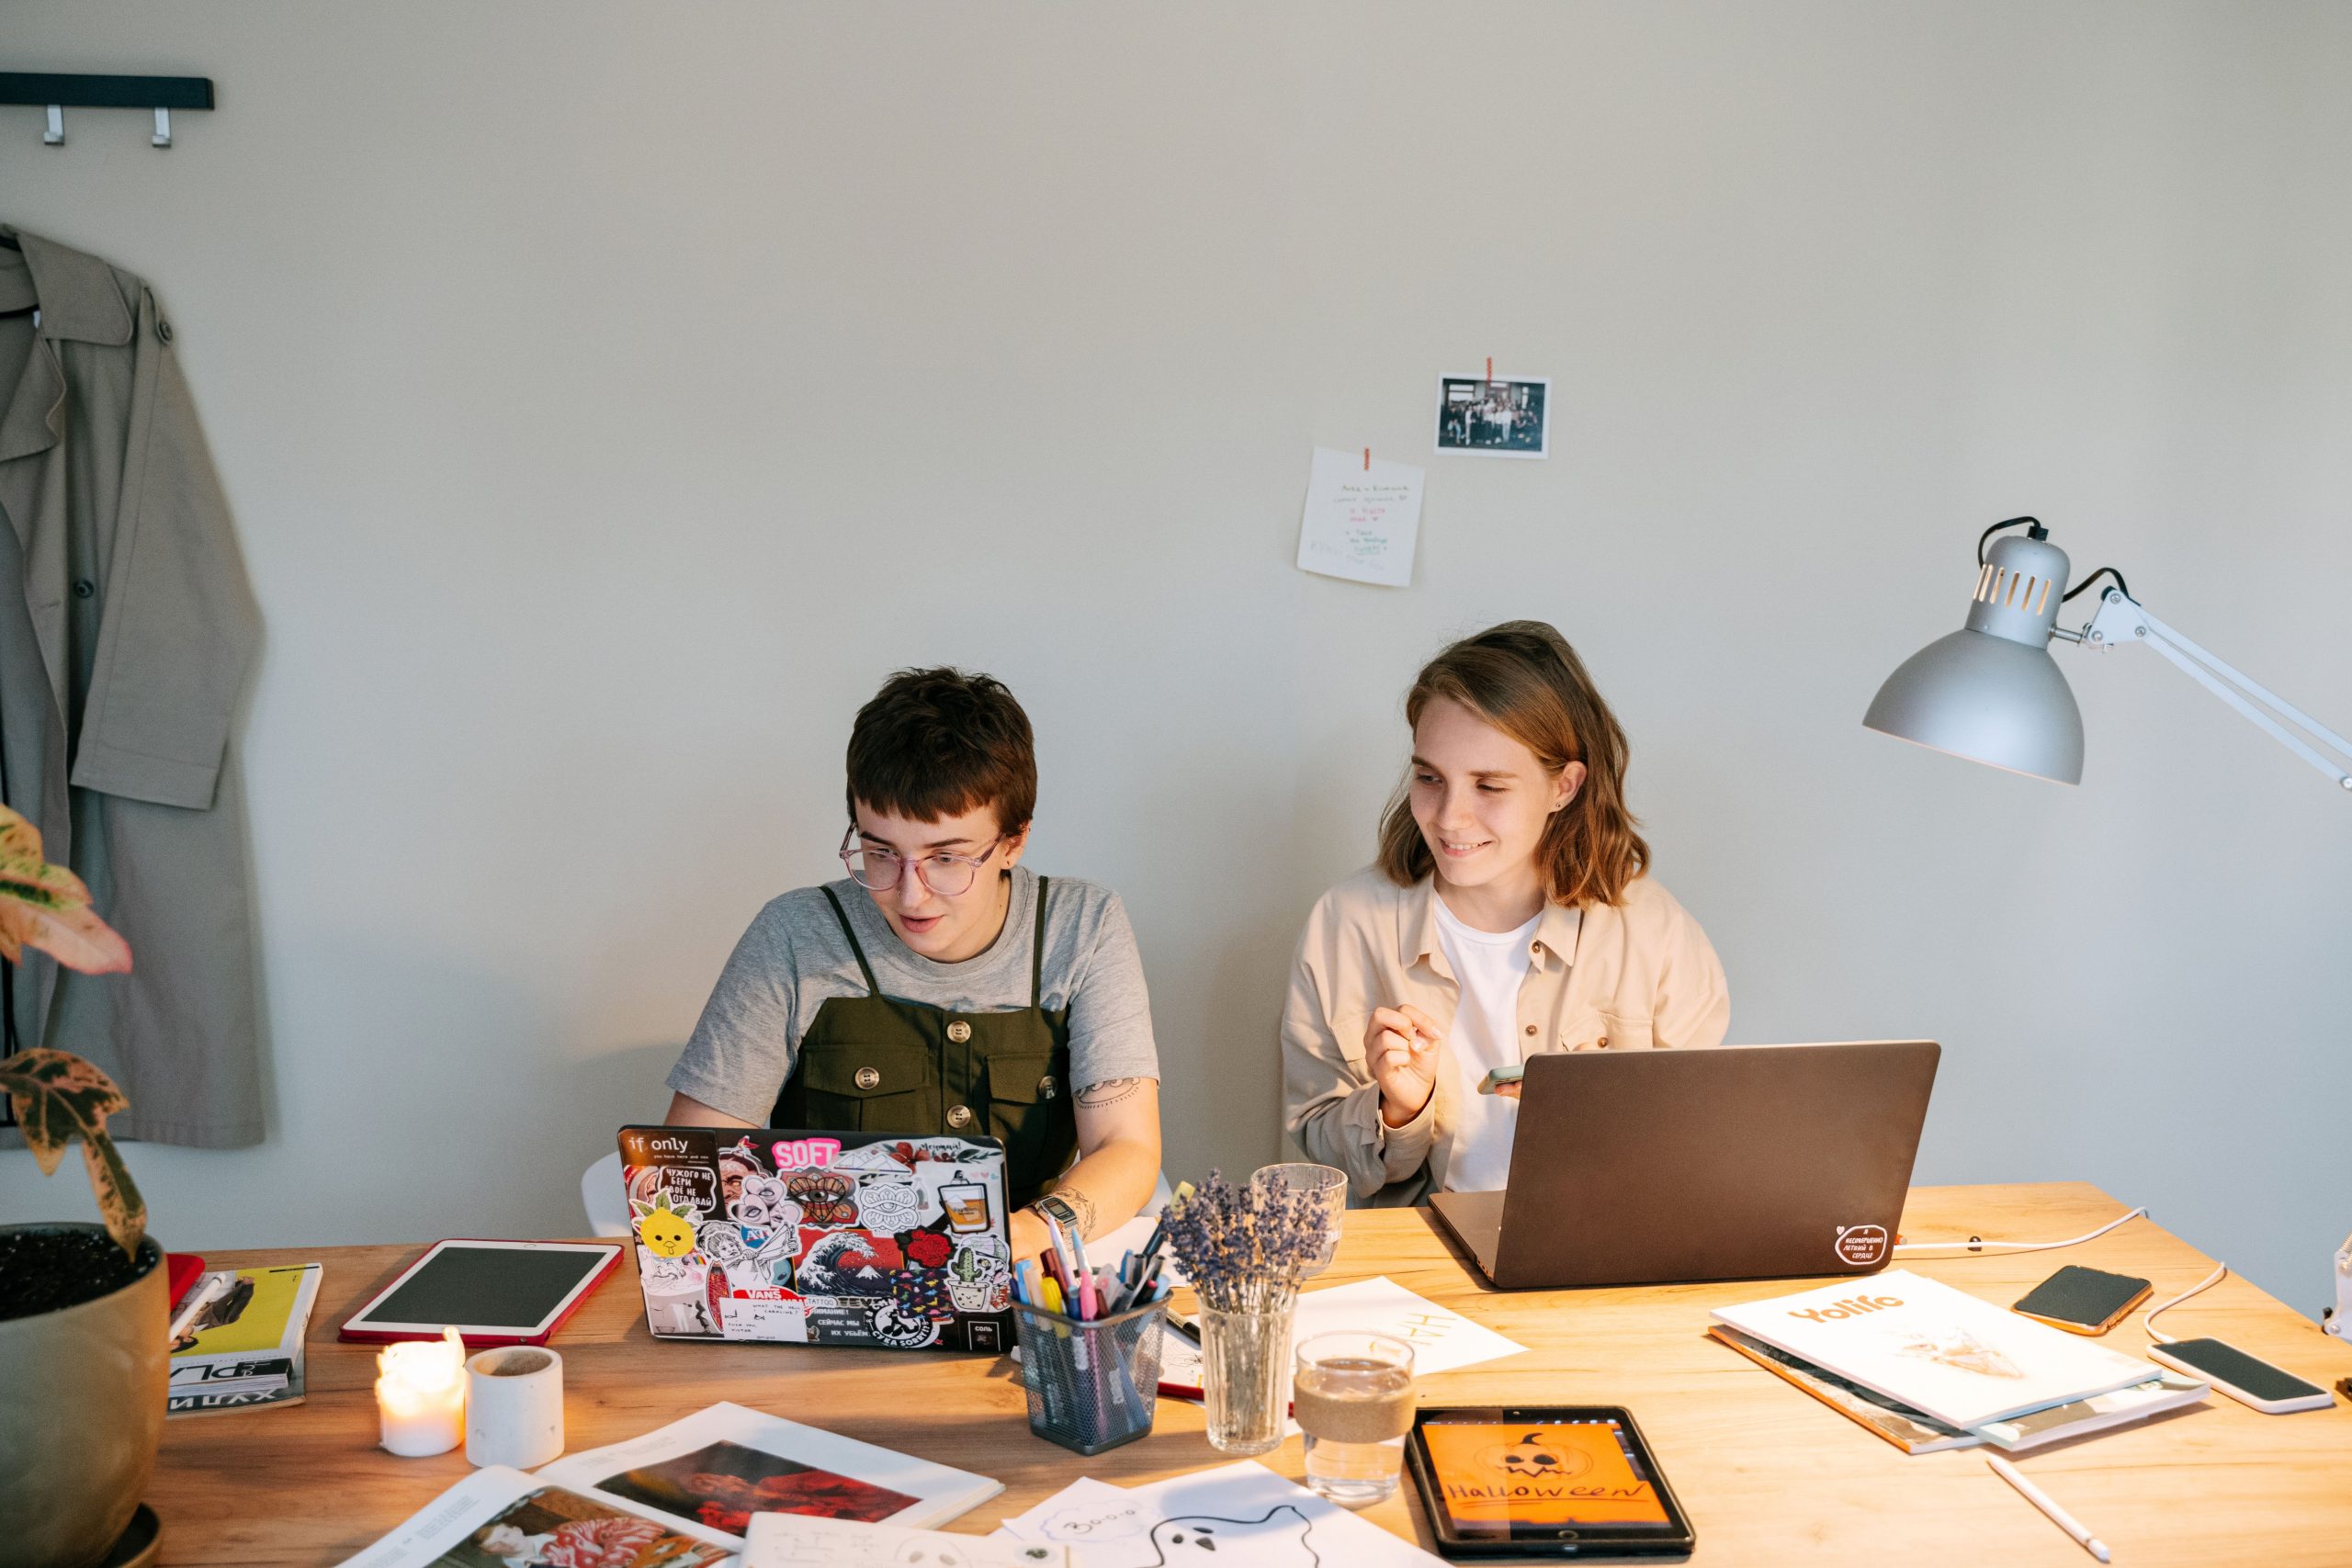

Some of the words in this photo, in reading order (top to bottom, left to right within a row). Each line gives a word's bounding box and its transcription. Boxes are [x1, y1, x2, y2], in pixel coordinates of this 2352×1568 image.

[628, 1137, 645, 1153] if
[650, 1137, 688, 1154] only
[775, 1142, 838, 1168] SOFT
[666, 1168, 699, 1179] ЧУЖОГО
[702, 1171, 712, 1181] НЕ
[671, 1177, 692, 1187] БЕРИ
[665, 1185, 684, 1194] ВОЁ
[686, 1188, 696, 1196] НЕ
[673, 1194, 712, 1207] ОТДАВАЙ
[748, 1289, 782, 1300] VANS
[811, 1307, 850, 1315] НИМАНИЕ!
[817, 1317, 844, 1326] СЕЙЧАС
[872, 1330, 898, 1346] СУКА
